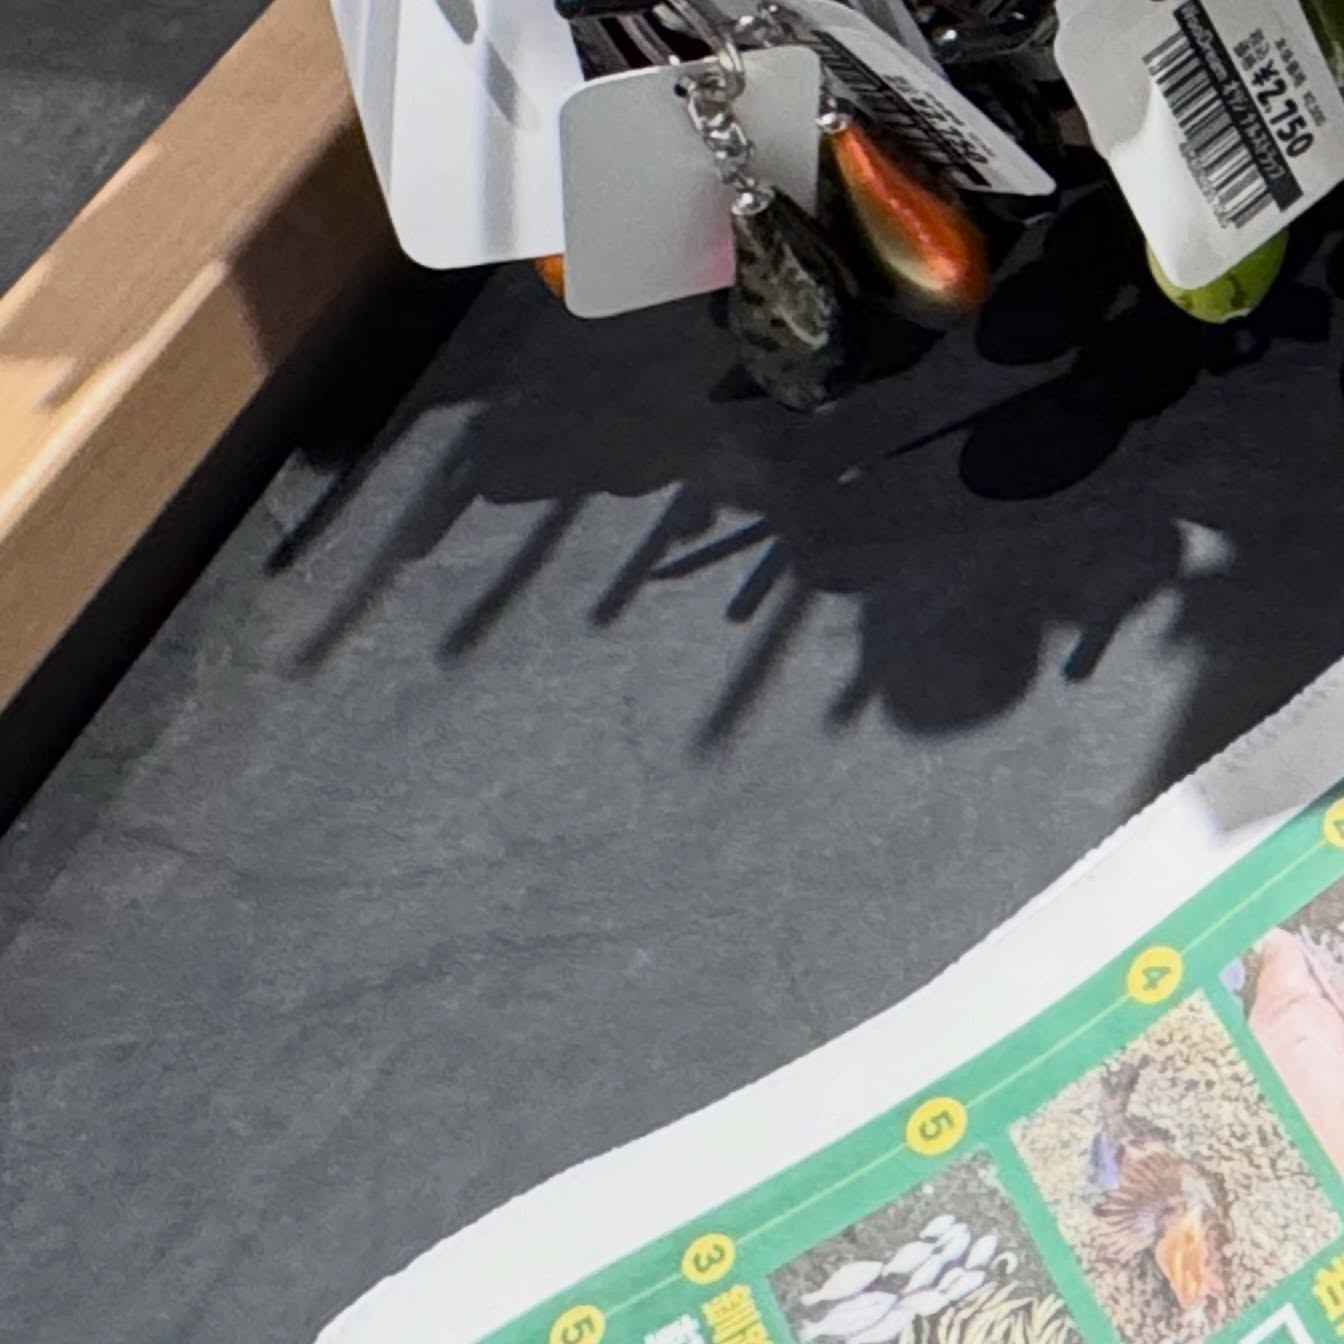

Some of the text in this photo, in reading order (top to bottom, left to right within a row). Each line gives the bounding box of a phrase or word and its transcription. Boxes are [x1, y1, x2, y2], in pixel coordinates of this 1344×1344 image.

[1140, 964, 1172, 991] 4
[920, 1109, 957, 1142] 5
[693, 1243, 726, 1274] 3
[560, 1316, 596, 1344] 5
